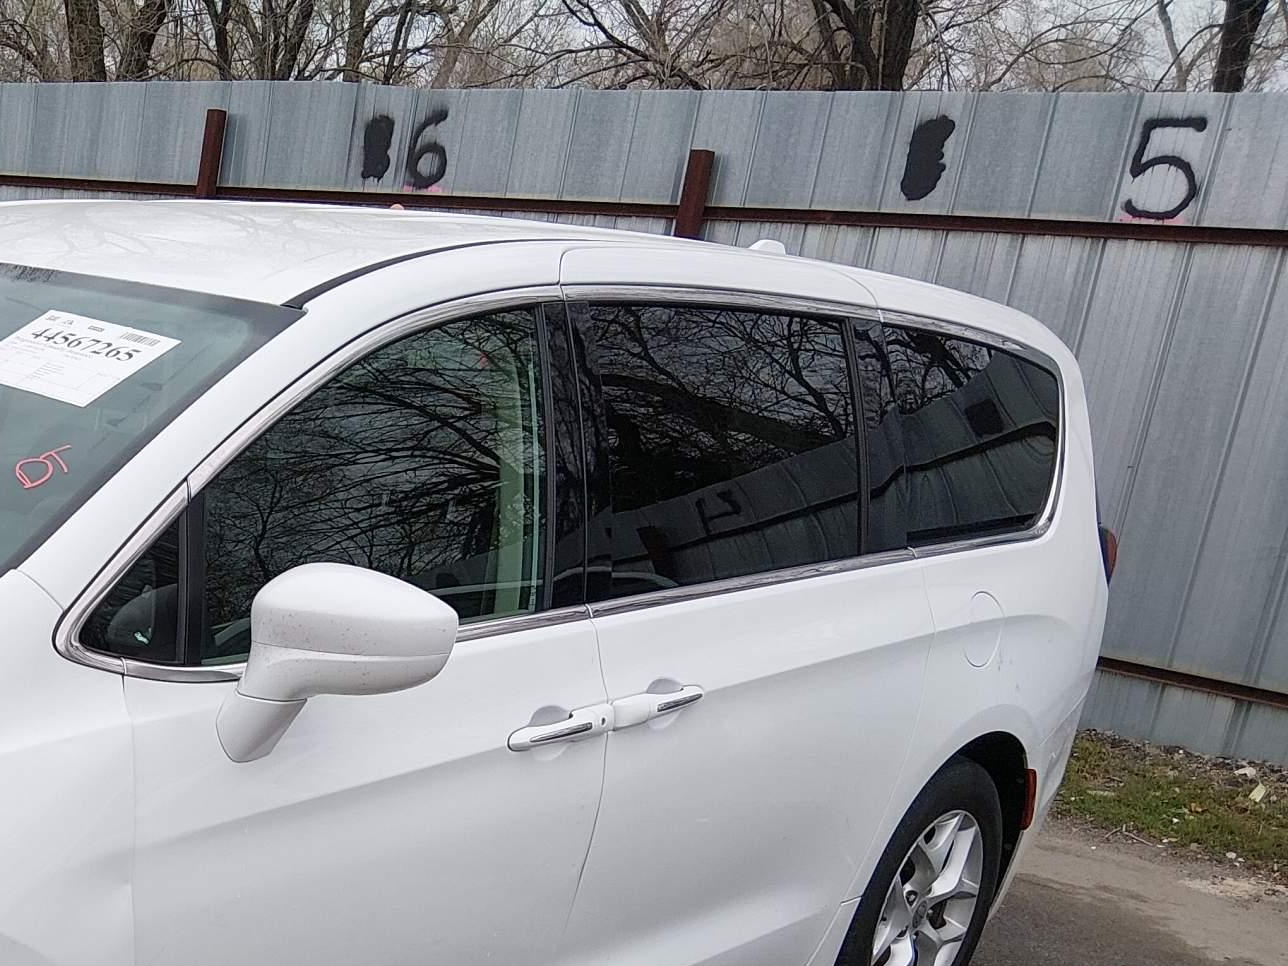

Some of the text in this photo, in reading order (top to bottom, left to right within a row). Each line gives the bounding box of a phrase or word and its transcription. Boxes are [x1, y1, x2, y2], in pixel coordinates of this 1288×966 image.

[407, 107, 450, 190] 6
[1122, 116, 1208, 221] 5
[31, 326, 143, 363] 44567265
